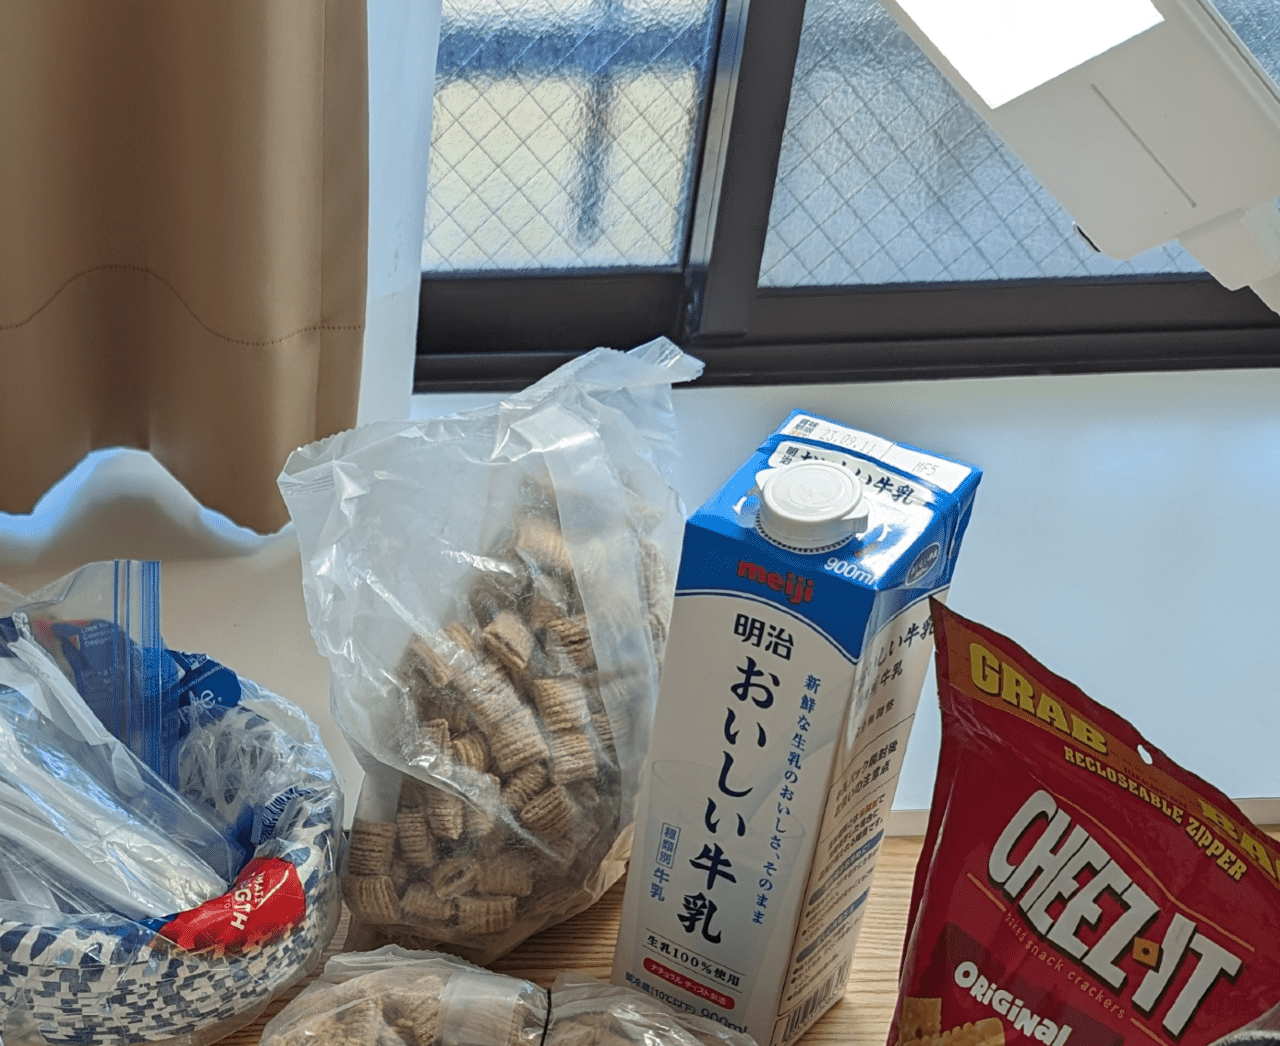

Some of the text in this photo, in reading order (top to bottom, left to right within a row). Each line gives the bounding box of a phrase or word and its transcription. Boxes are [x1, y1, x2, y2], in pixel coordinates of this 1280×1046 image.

[737, 558, 815, 604] meiji
[824, 556, 876, 585] 900ml
[733, 613, 795, 661] 明治
[969, 642, 1108, 756] GRAB
[675, 655, 781, 945] おいしい牛乳
[751, 673, 821, 926] 新鮮な生乳のおいしさ、そのまま
[1063, 745, 1186, 827] RECLOSEABLE
[1185, 816, 1250, 882] ZIPPER
[646, 935, 740, 987] 生乳100%使用
[1026, 940, 1065, 973] snack
[1066, 970, 1126, 1020] crackers
